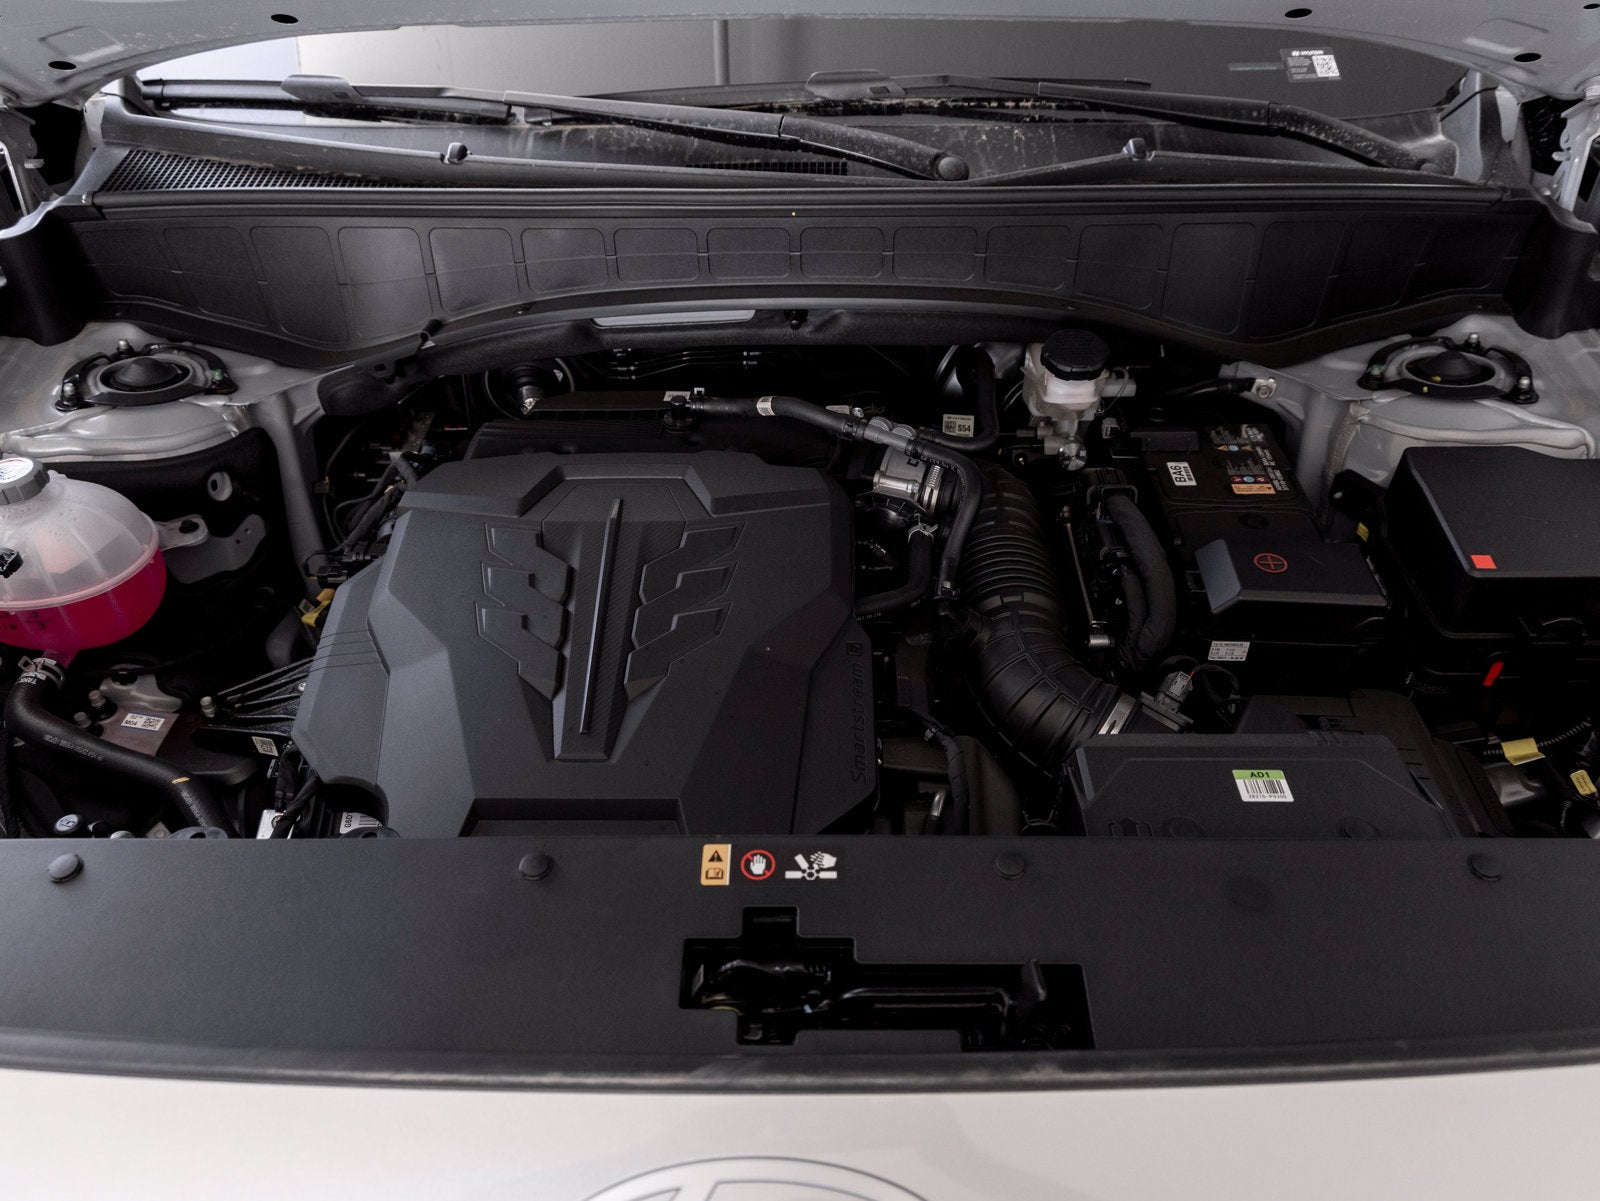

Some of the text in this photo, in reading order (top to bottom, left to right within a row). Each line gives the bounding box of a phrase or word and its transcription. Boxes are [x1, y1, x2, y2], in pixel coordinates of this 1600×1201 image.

[957, 424, 971, 433] S54
[1169, 465, 1187, 482] BA6
[850, 663, 867, 785] Smartstream
